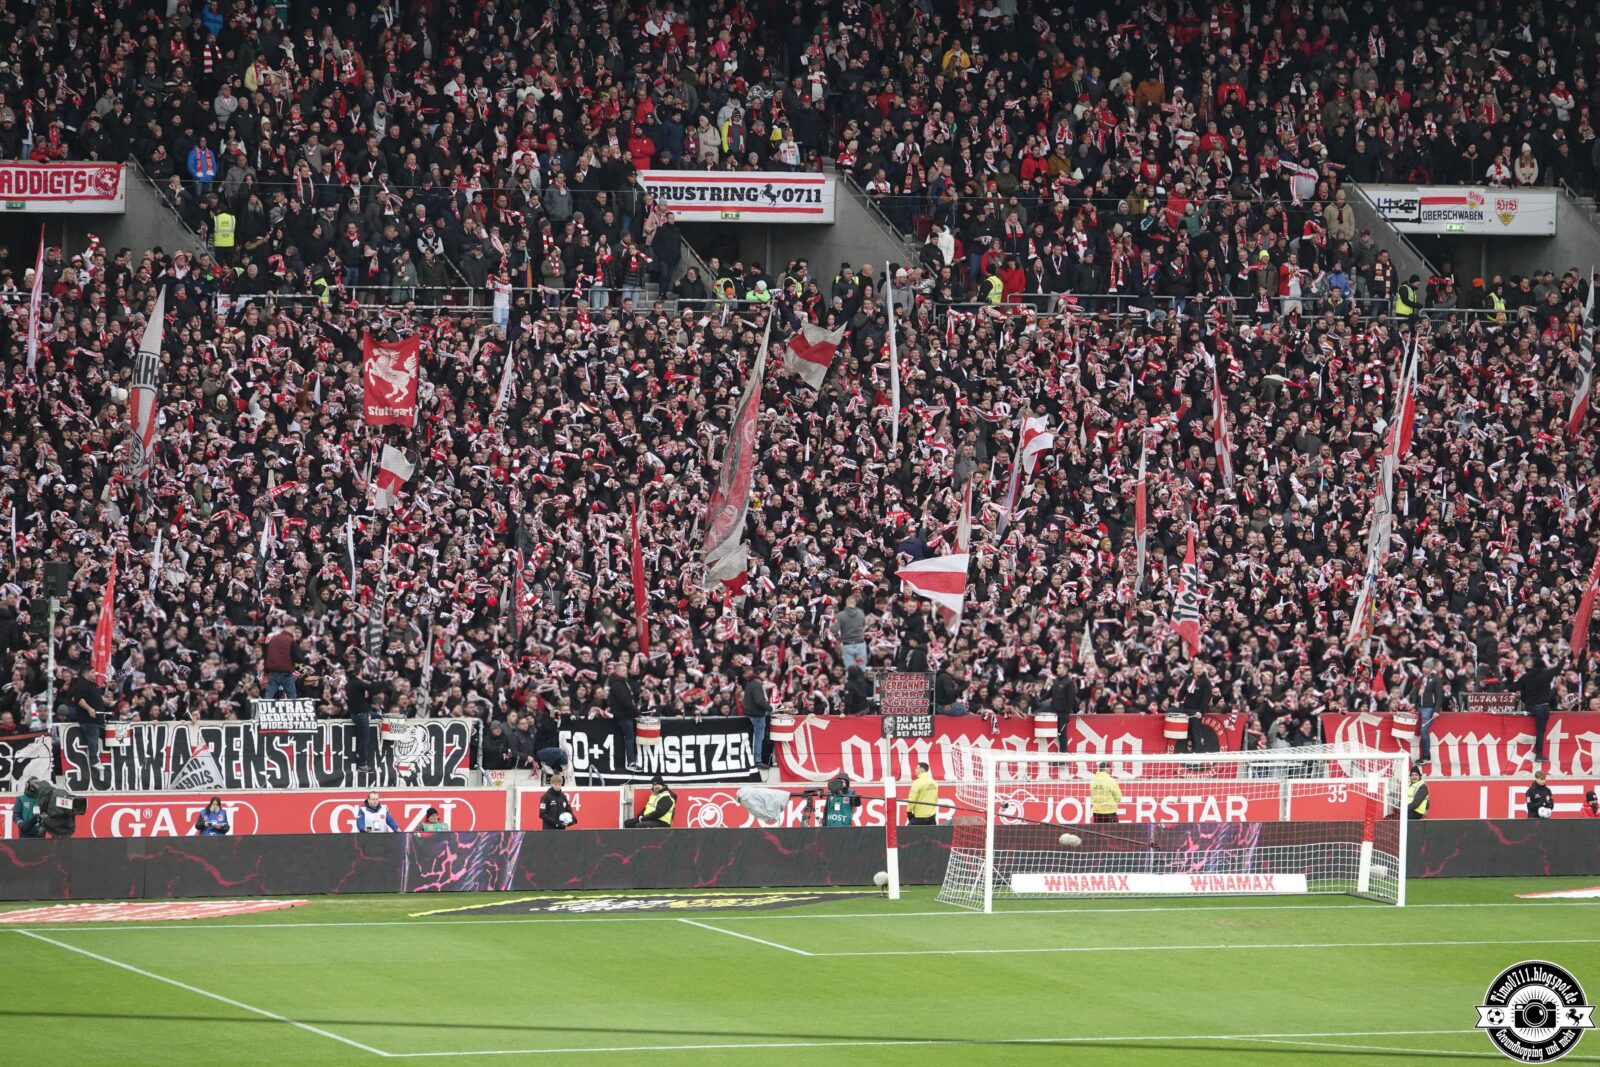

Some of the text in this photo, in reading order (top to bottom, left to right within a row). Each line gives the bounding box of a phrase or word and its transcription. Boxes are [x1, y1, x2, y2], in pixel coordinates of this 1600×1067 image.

[0, 170, 87, 195] ADDICTS
[646, 185, 822, 203] BRUSTRING 0711
[1422, 210, 1484, 221] OBERSCHWABEN
[368, 405, 413, 417] Stuttgart
[1468, 695, 1497, 703] ULTRA
[259, 701, 315, 713] ULTRAS
[260, 713, 315, 721] BEDEUTET
[1328, 785, 1347, 802] 35
[827, 814, 847, 822] HOST
[1044, 875, 1130, 891] WINAMAX
[1190, 875, 1275, 891] WINAMAX
